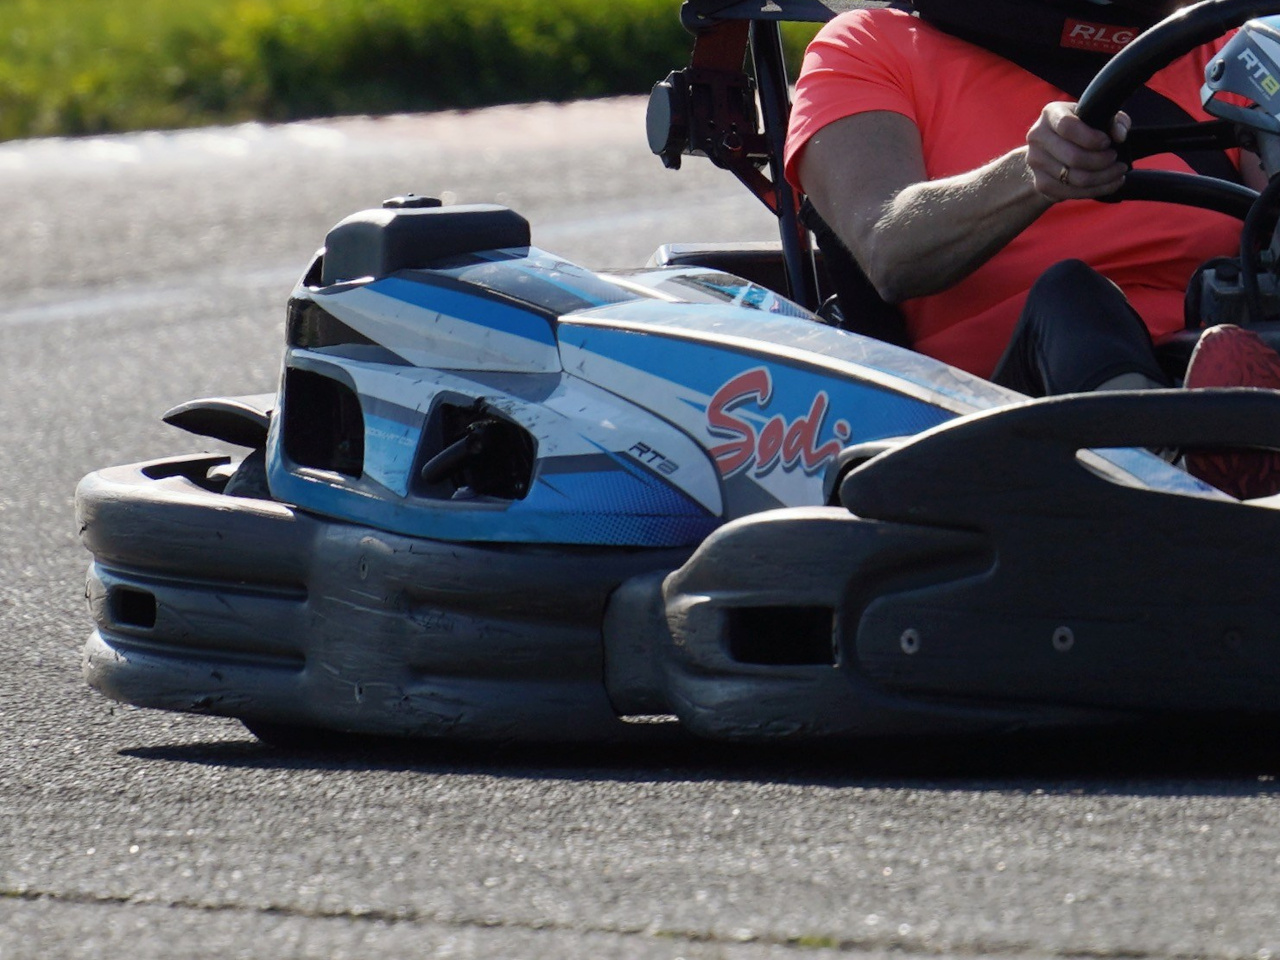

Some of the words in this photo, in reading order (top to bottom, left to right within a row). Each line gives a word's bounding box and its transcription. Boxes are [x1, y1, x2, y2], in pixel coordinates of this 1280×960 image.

[1069, 24, 1134, 44] RLG
[1237, 47, 1280, 96] RT8
[706, 366, 852, 480] Sodi
